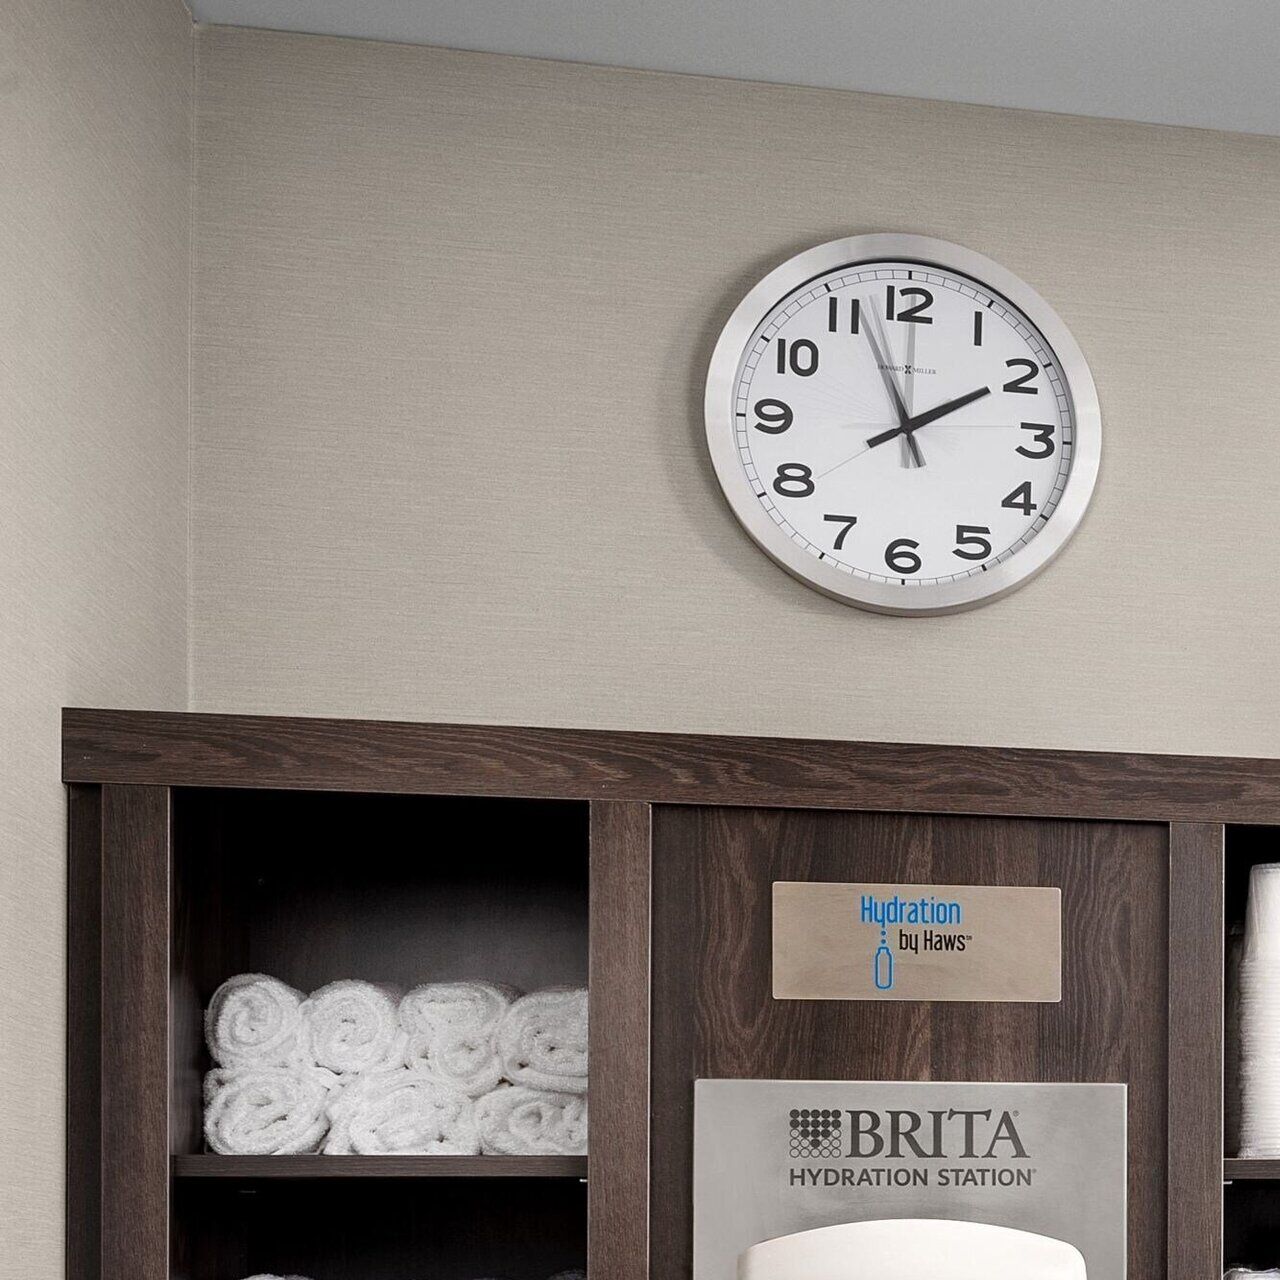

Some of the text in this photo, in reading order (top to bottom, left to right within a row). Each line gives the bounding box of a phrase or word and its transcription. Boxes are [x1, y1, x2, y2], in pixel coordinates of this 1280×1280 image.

[829, 297, 860, 334] 11
[886, 285, 934, 324] 12
[974, 311, 983, 346] 1
[777, 338, 819, 377] 10
[1002, 358, 1039, 395] 2
[754, 398, 793, 434] 9
[1015, 422, 1055, 459] 3
[773, 463, 815, 498] 8
[1001, 481, 1037, 516] 4
[823, 514, 857, 550] 7
[952, 525, 992, 561] 5
[884, 538, 922, 574] 6
[860, 895, 961, 928] Hydration
[899, 929, 918, 954] by
[845, 1108, 1031, 1158] BRITA
[789, 1168, 1032, 1186] HYDRATION STATION
